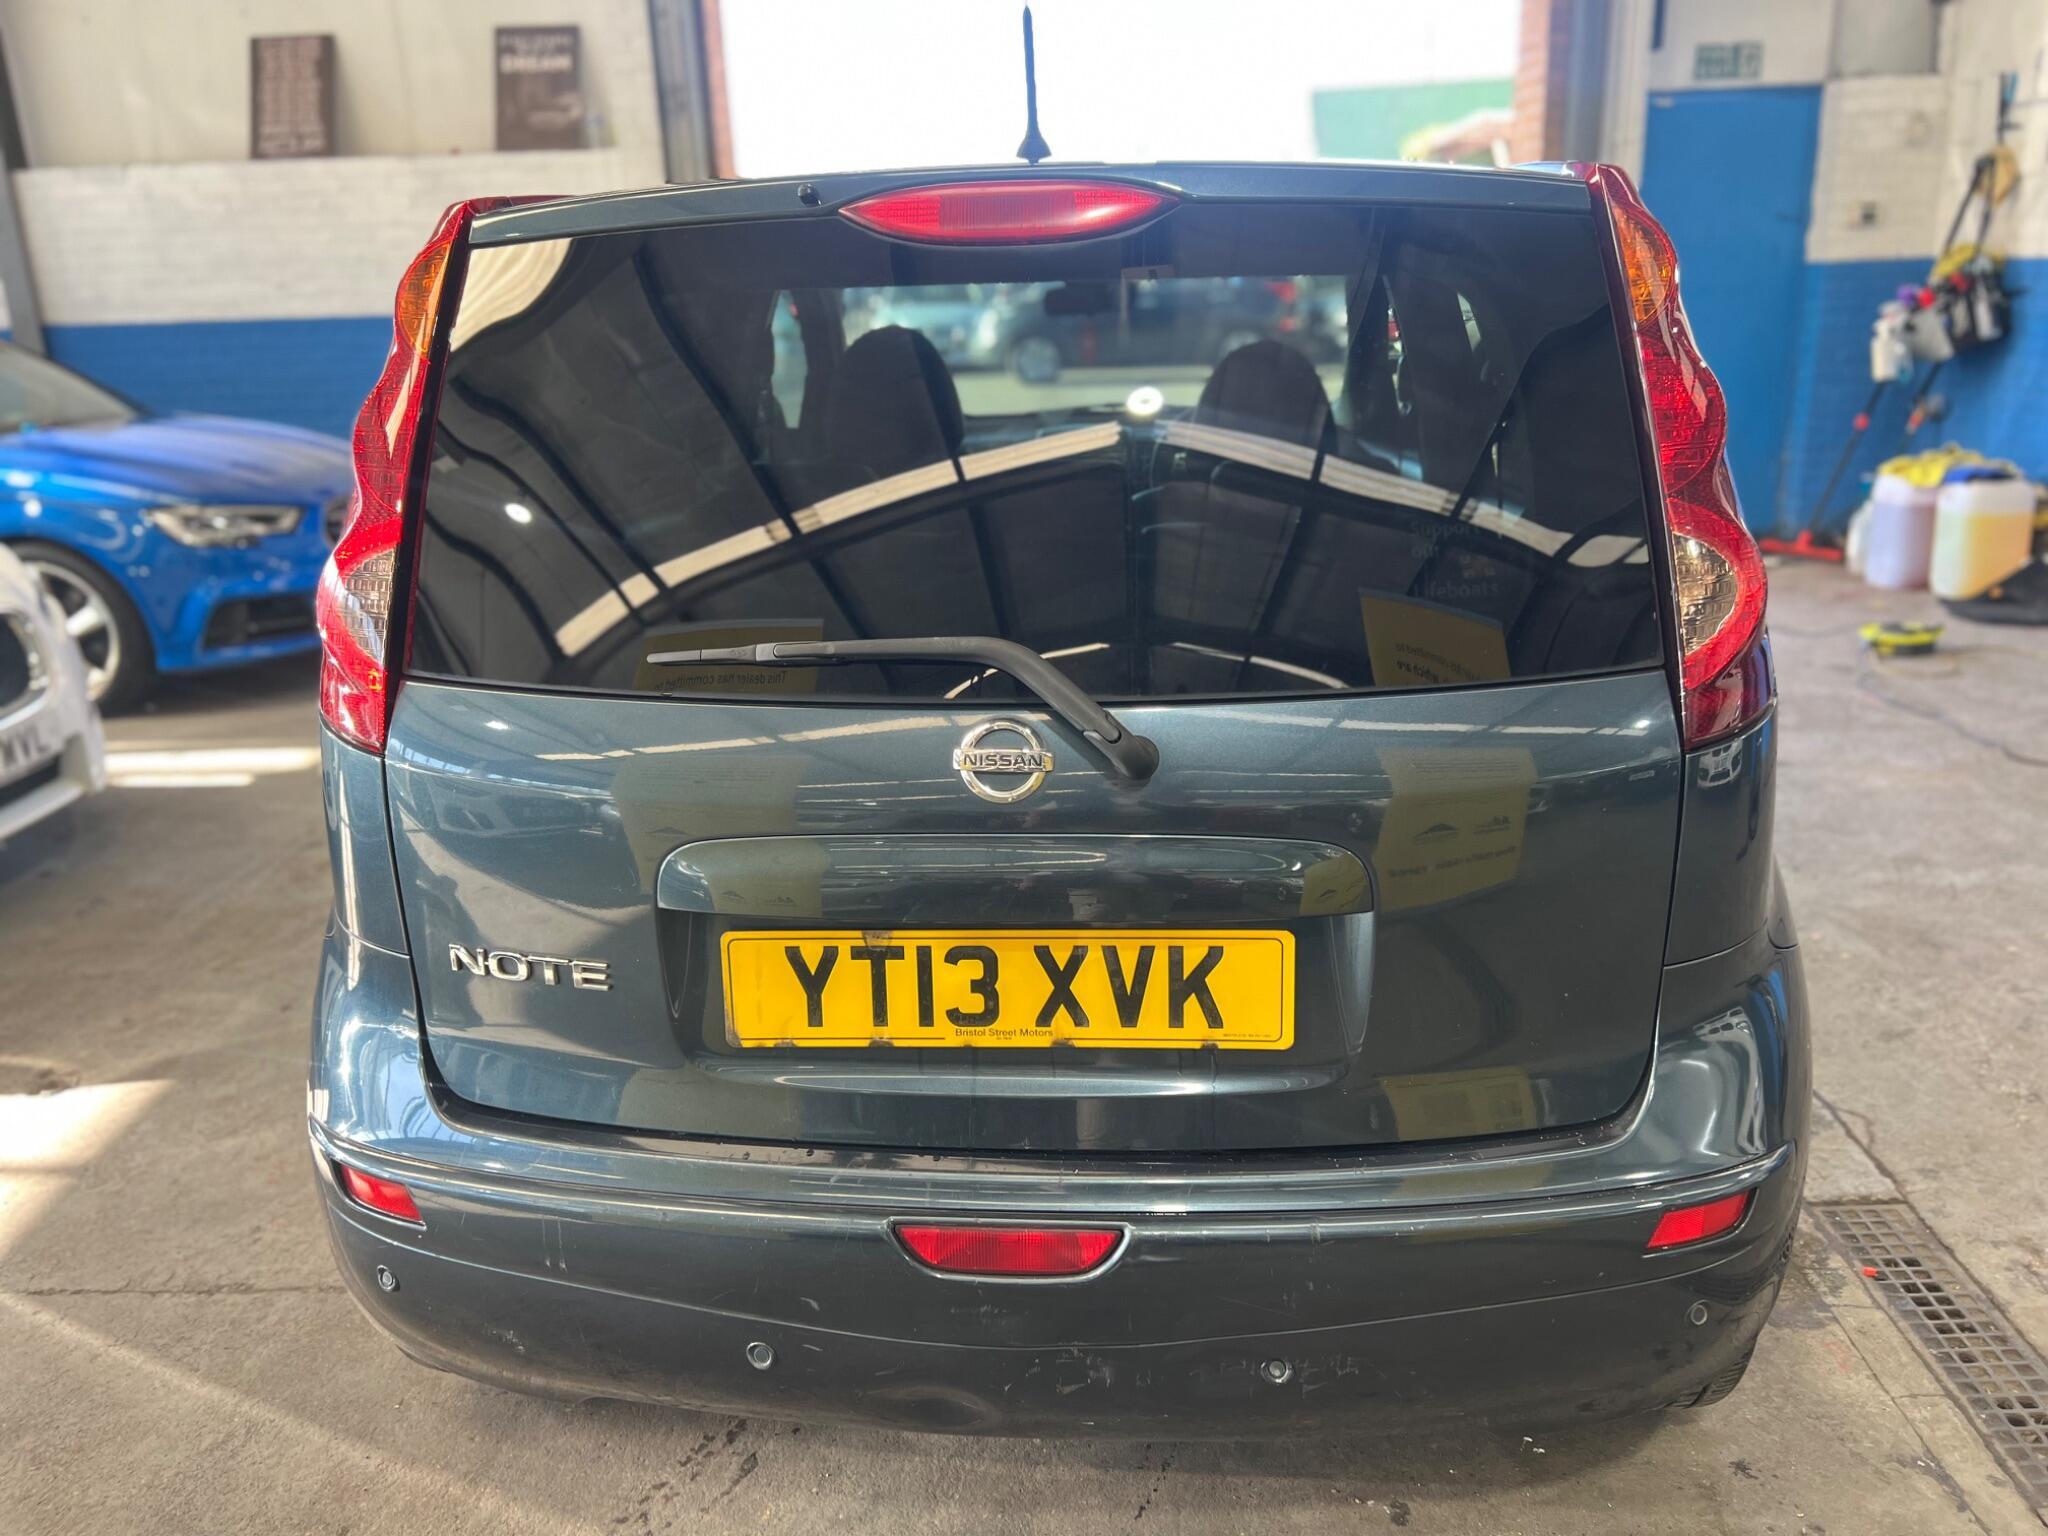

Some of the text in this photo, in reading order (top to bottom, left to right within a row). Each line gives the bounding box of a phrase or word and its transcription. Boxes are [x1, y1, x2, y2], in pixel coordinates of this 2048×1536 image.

[1414, 581, 1498, 598] Lifeboats
[963, 754, 1043, 768] NISSAN
[449, 944, 609, 991] NOTE
[785, 945, 1224, 1028] YT13 XVK
[955, 1028, 1054, 1037] Bristol Street Motors
